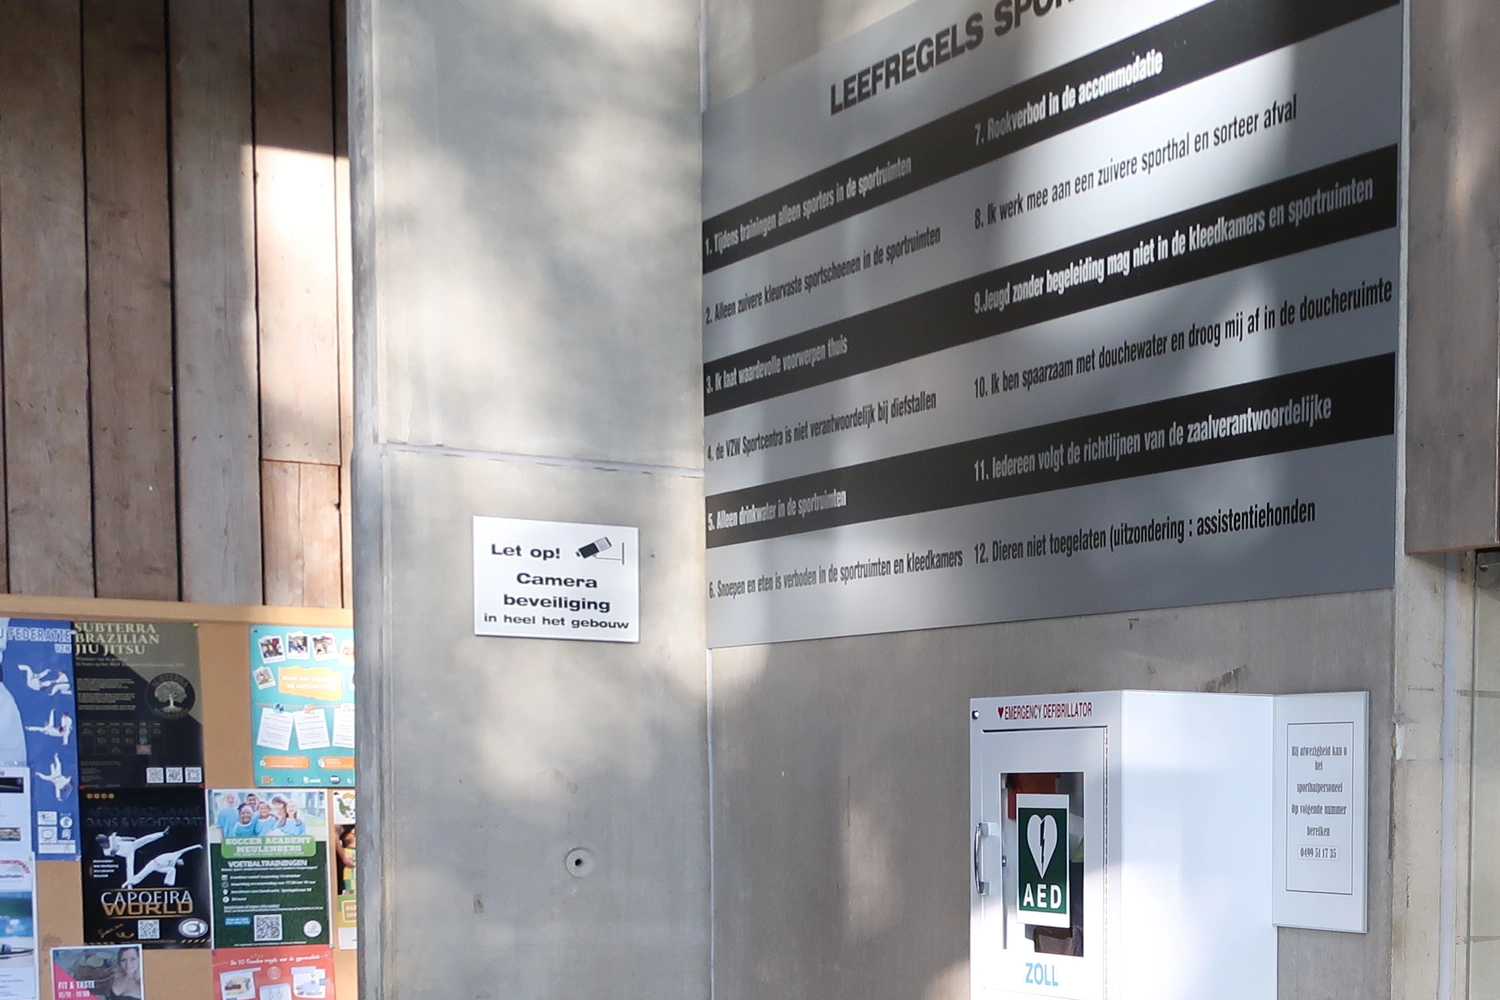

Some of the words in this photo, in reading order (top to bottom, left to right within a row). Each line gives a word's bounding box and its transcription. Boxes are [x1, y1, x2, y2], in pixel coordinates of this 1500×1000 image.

[831, 13, 983, 116] LEEFREGELS
[975, 124, 984, 145] 7.
[987, 95, 1046, 138] Rookverbod
[1049, 91, 1059, 116] in
[1061, 85, 1076, 111] de
[1078, 48, 1163, 104] accommodatie
[975, 208, 983, 229] 8.
[987, 203, 996, 223] Ik
[1000, 193, 1023, 220] werk
[1027, 188, 1048, 211] mee
[1052, 181, 1070, 202] aan
[1075, 172, 1094, 194] een
[1098, 157, 1137, 186] zuivere
[1141, 132, 1189, 176] sporthal
[1195, 131, 1209, 152] en
[1214, 113, 1258, 147] sorteer
[1264, 94, 1297, 129] afval
[1013, 273, 1044, 302] zonder
[1046, 256, 1104, 295] begeleiding
[1107, 250, 1130, 275] mag
[1133, 238, 1154, 268] niet
[1158, 235, 1168, 260] in
[1172, 230, 1185, 254] de
[1189, 209, 1264, 251] kleedkamers
[1269, 204, 1284, 228] en
[1288, 177, 1373, 227] sportruimten
[974, 377, 988, 398] 10.
[991, 373, 999, 394] Ik
[1003, 370, 1019, 392] ben
[1022, 359, 1073, 391] spaarzaam
[1076, 349, 1095, 374] met
[1099, 334, 1167, 369] douchewater
[1171, 330, 1184, 351] en
[1189, 322, 1220, 348] droog
[1225, 312, 1243, 342] mij
[1248, 307, 1259, 334] af
[1264, 305, 1275, 330] in
[1280, 301, 1295, 327] de
[1300, 277, 1392, 322] doucheruimte
[974, 460, 989, 481] 11.
[992, 453, 1035, 478] Iedereen
[1038, 444, 1064, 472] volgt
[1067, 441, 1080, 465] de
[1084, 432, 1140, 462] richtlijnen
[1144, 429, 1165, 452] van
[1169, 422, 1184, 446] de
[1187, 394, 1332, 443] zaalverantwoordelijke
[974, 543, 989, 564] 12.
[992, 540, 1023, 561] Dieren
[1027, 534, 1046, 556] niet
[1050, 527, 1106, 557] toegelaten
[1110, 516, 1184, 552] (uitzondering
[1197, 498, 1315, 536] assistentiehonden
[491, 544, 521, 556] Let
[530, 548, 560, 560] op!
[516, 573, 597, 588] Camera
[709, 581, 715, 598] 6.
[717, 579, 745, 599] Snoepen
[748, 578, 755, 592] en
[758, 574, 773, 592] eten
[775, 572, 781, 590] is
[784, 567, 817, 589] verboden
[819, 565, 826, 584] in
[829, 564, 838, 583] de
[840, 556, 891, 585] sportruimten
[893, 558, 904, 574] en
[906, 550, 963, 572] kleedkamers
[504, 594, 610, 613] beveiliging
[75, 623, 156, 633] SUBTERRA
[484, 613, 496, 622] in
[504, 615, 535, 624] heel
[542, 617, 565, 626] het
[571, 619, 629, 629] gebouw
[8, 627, 71, 642] FEDERATIE
[75, 634, 159, 644] BRAZILIAN
[76, 644, 99, 655] JIU
[104, 644, 145, 655] JITSU
[1005, 705, 1041, 720] EMERGENCY
[1044, 702, 1092, 718] DEFIBRILLATOR
[1332, 746, 1342, 756] kan
[1322, 849, 1328, 858] 17
[101, 891, 193, 905] CAPOEIRA
[1023, 883, 1062, 909] AED
[102, 900, 193, 915] WORLD
[1026, 962, 1058, 986] ZOLL
